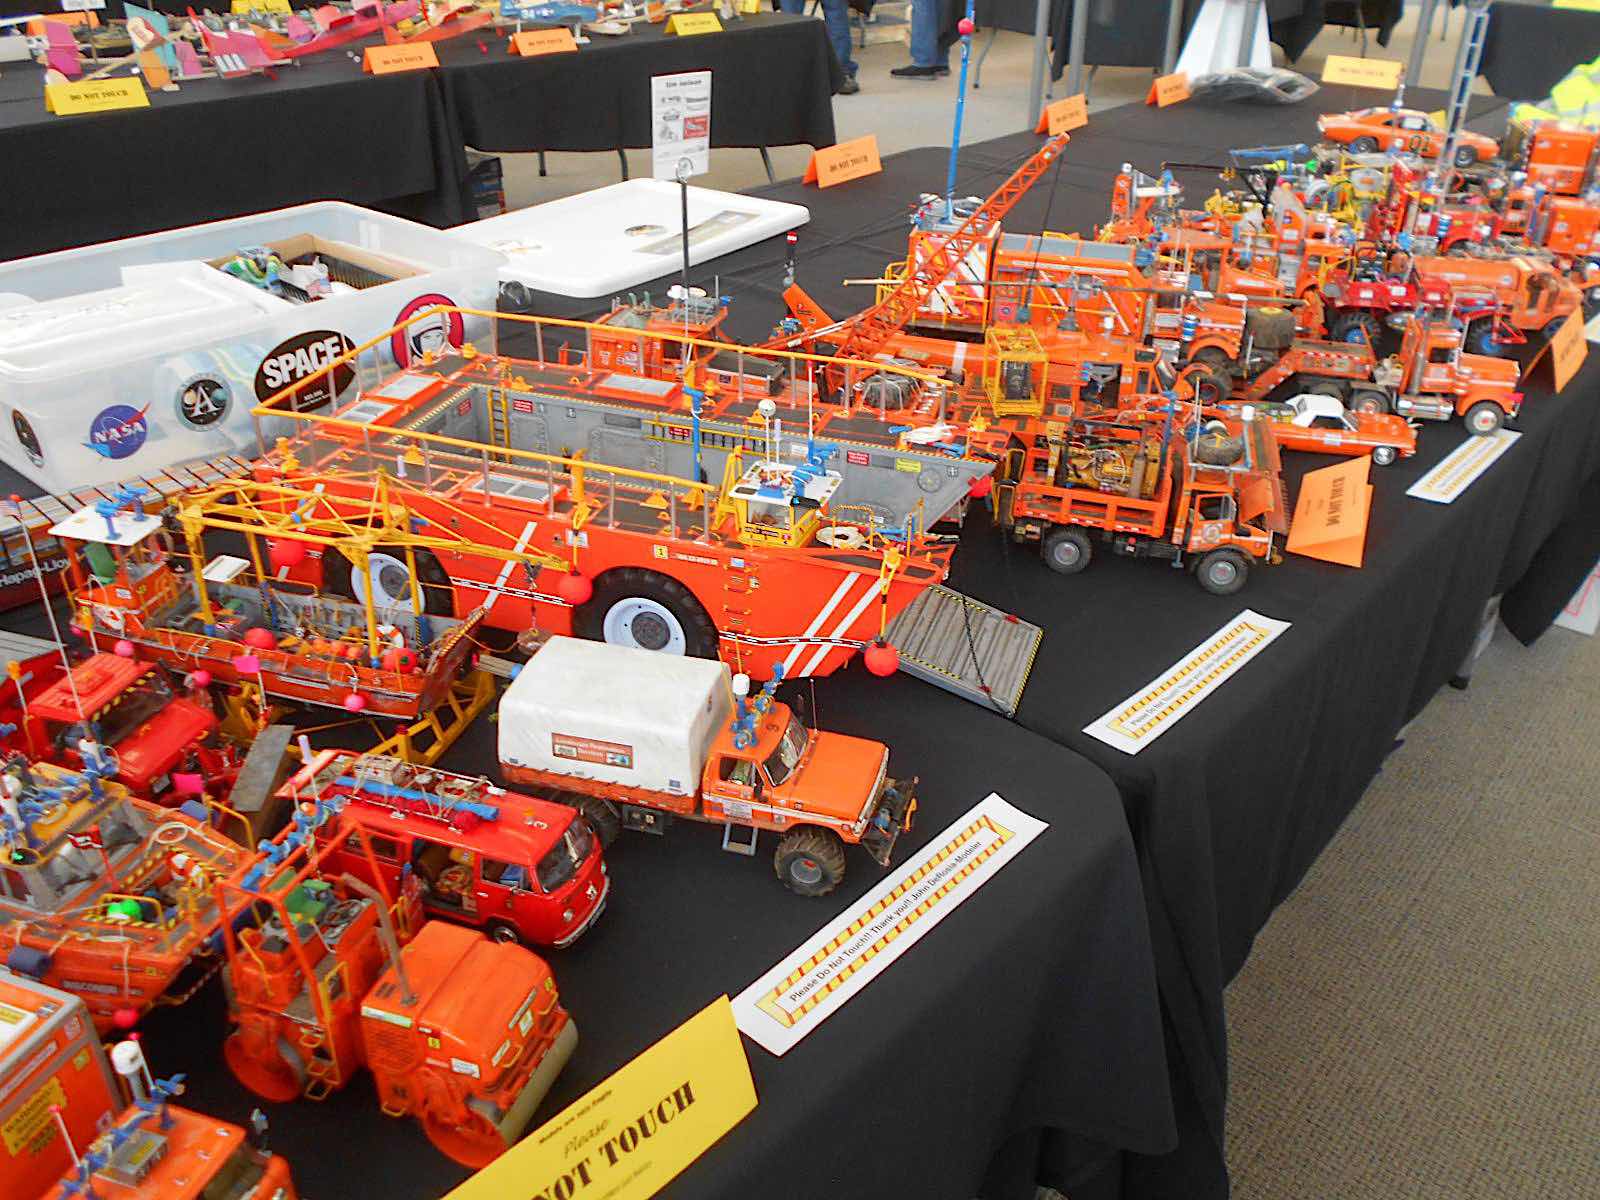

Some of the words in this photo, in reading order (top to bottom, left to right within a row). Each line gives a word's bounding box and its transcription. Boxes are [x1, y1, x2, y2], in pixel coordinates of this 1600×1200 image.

[94, 421, 146, 443] NASA
[789, 978, 818, 1002] Please
[815, 968, 831, 981] Do
[829, 956, 844, 970] Not
[842, 931, 873, 959] Touch!!
[870, 912, 895, 935] Thank
[911, 886, 930, 902] John
[563, 1118, 610, 1160] Please
[598, 1079, 696, 1169] TOUCH
